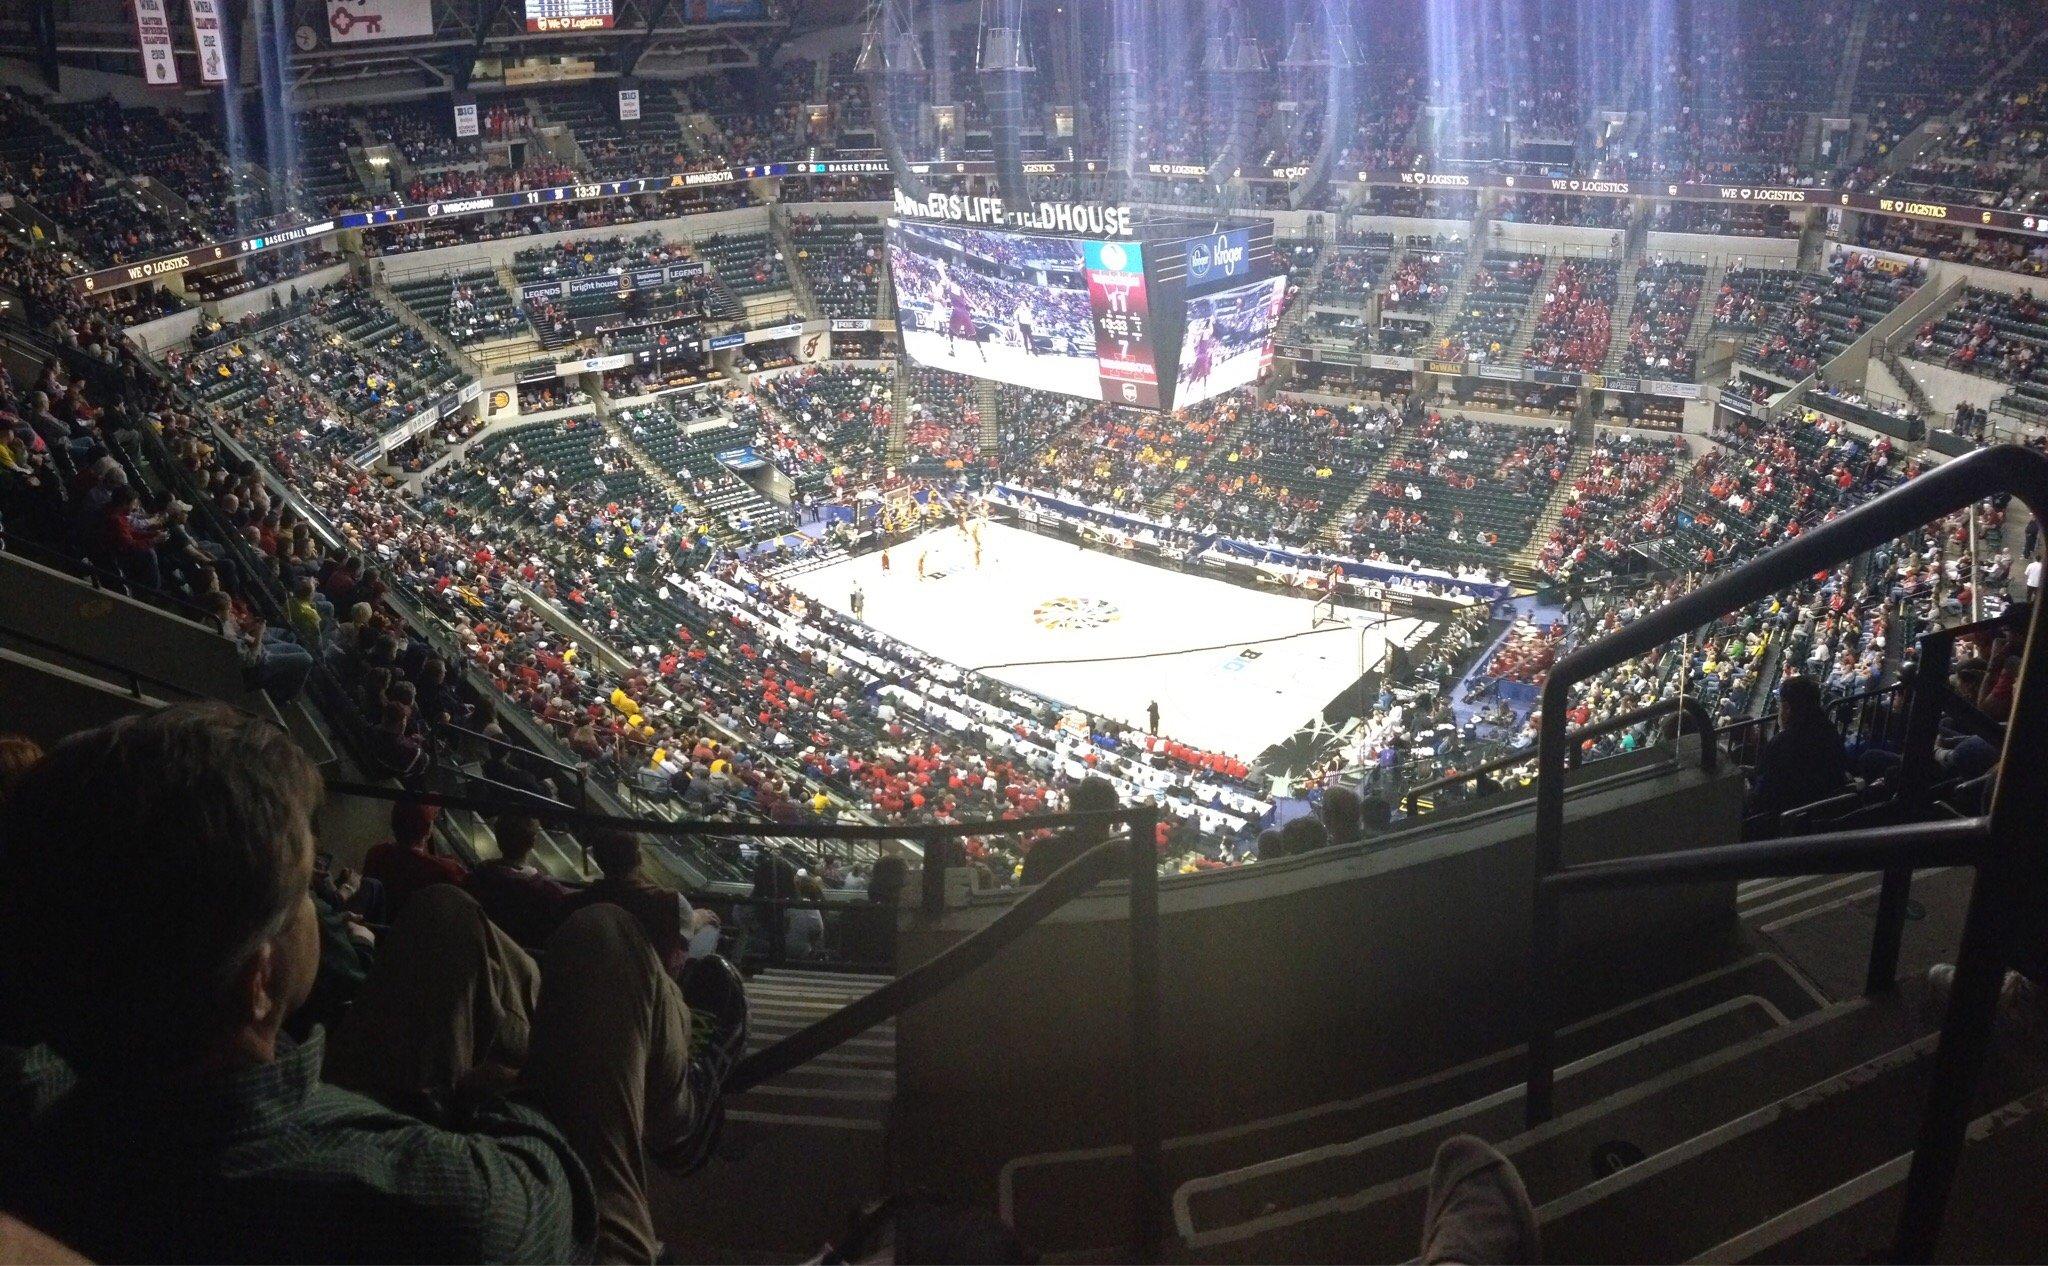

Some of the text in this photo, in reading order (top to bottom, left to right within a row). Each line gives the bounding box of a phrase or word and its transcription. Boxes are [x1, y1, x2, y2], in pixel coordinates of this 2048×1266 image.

[547, 17, 604, 29] We Logistics
[829, 164, 890, 172] BASKETBALL
[1022, 163, 1055, 173] OGISTICS
[685, 171, 734, 185] MINNESOTA
[1401, 172, 1469, 186] WE LOGISTICS
[575, 185, 601, 198] 13:37
[1551, 179, 1629, 193] WE LOGISTICS
[526, 192, 539, 204] 11
[1721, 188, 1805, 201] WE LOGISTICS
[442, 199, 494, 214] WISCONSIN
[963, 195, 1004, 225] LIFE
[1880, 199, 1947, 218] WE LOGISTICS
[264, 229, 305, 246] BASKETBALL
[1214, 235, 1243, 276] Kroger
[128, 255, 190, 280] WE LOGISTICS
[670, 267, 703, 278] LEGENDS
[571, 279, 618, 293] bright house
[524, 287, 561, 300] LEGENDS
[1109, 290, 1127, 312] 11
[1118, 340, 1129, 359] 7
